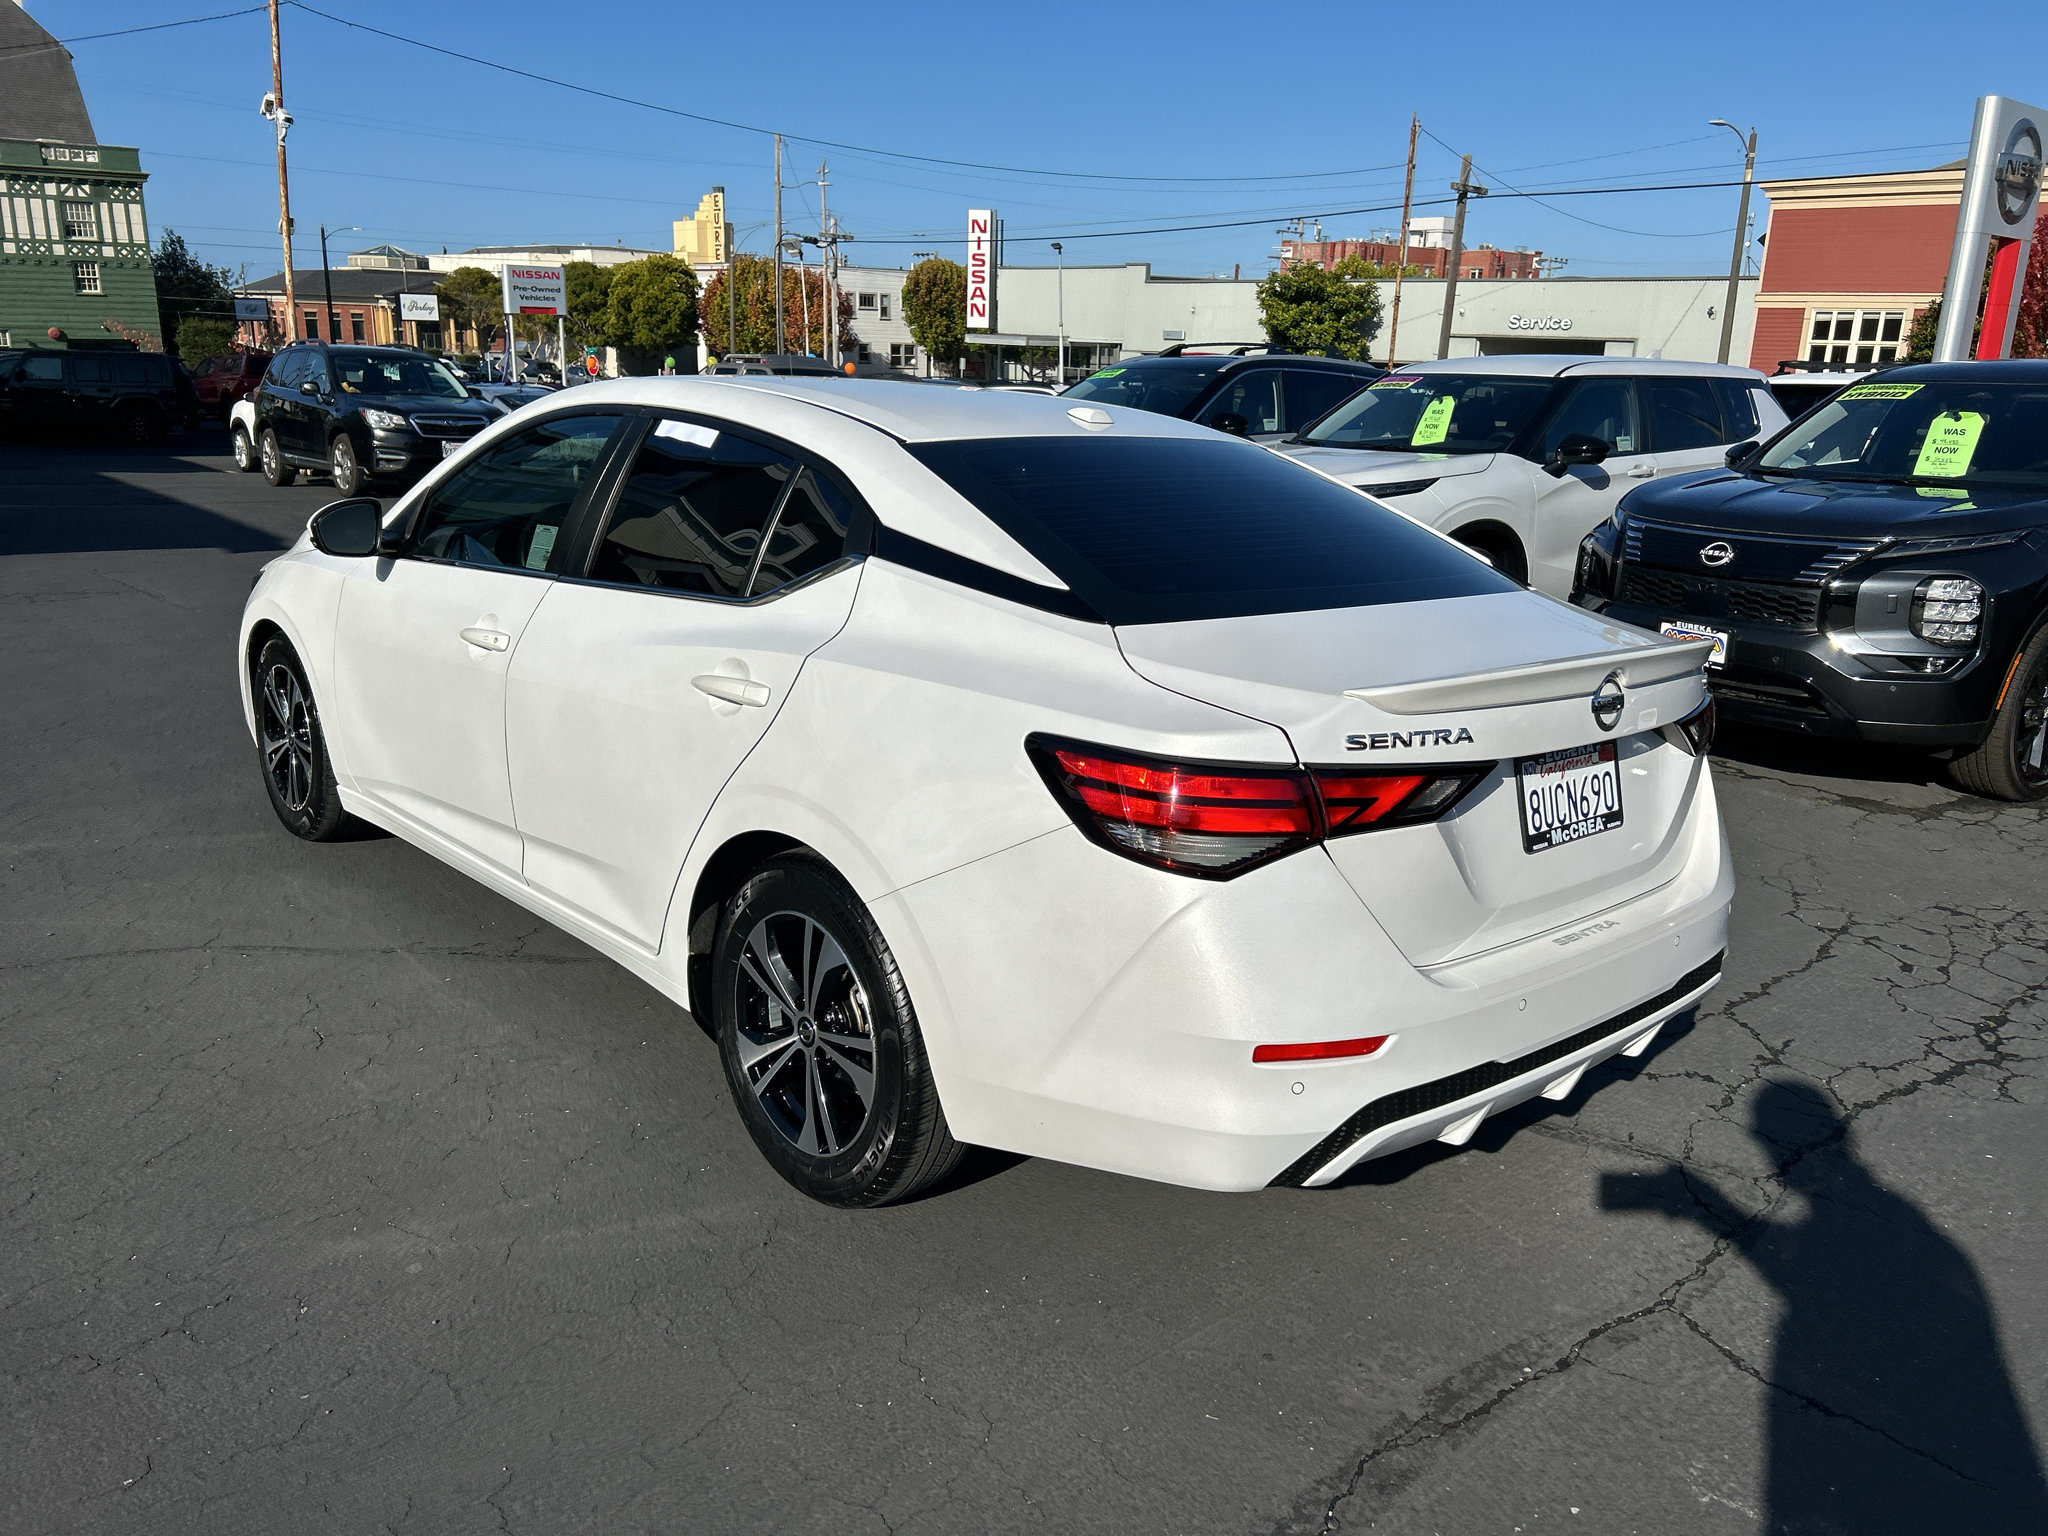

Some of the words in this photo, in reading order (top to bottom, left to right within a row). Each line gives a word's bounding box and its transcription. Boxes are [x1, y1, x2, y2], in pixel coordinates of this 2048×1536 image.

[512, 269, 560, 280] NISSAN
[970, 219, 987, 317] NISSAN
[513, 285, 561, 294] Pre-Owned
[519, 294, 556, 302] Vehicles
[407, 300, 435, 315] Parking
[1508, 314, 1572, 330] Service
[1841, 391, 1908, 399] HYBRID
[1944, 428, 1966, 436] WAS
[1934, 446, 1959, 454] NOW
[1700, 548, 1734, 559] NISSAN
[1676, 621, 1712, 633] EUREKA
[1345, 727, 1475, 751] SENTRA
[1522, 761, 1537, 776] NOV
[1539, 754, 1599, 780] California
[1528, 770, 1615, 833] 8UCN690
[1550, 816, 1605, 845] McCREA
[1551, 920, 1620, 946] SENTRA
